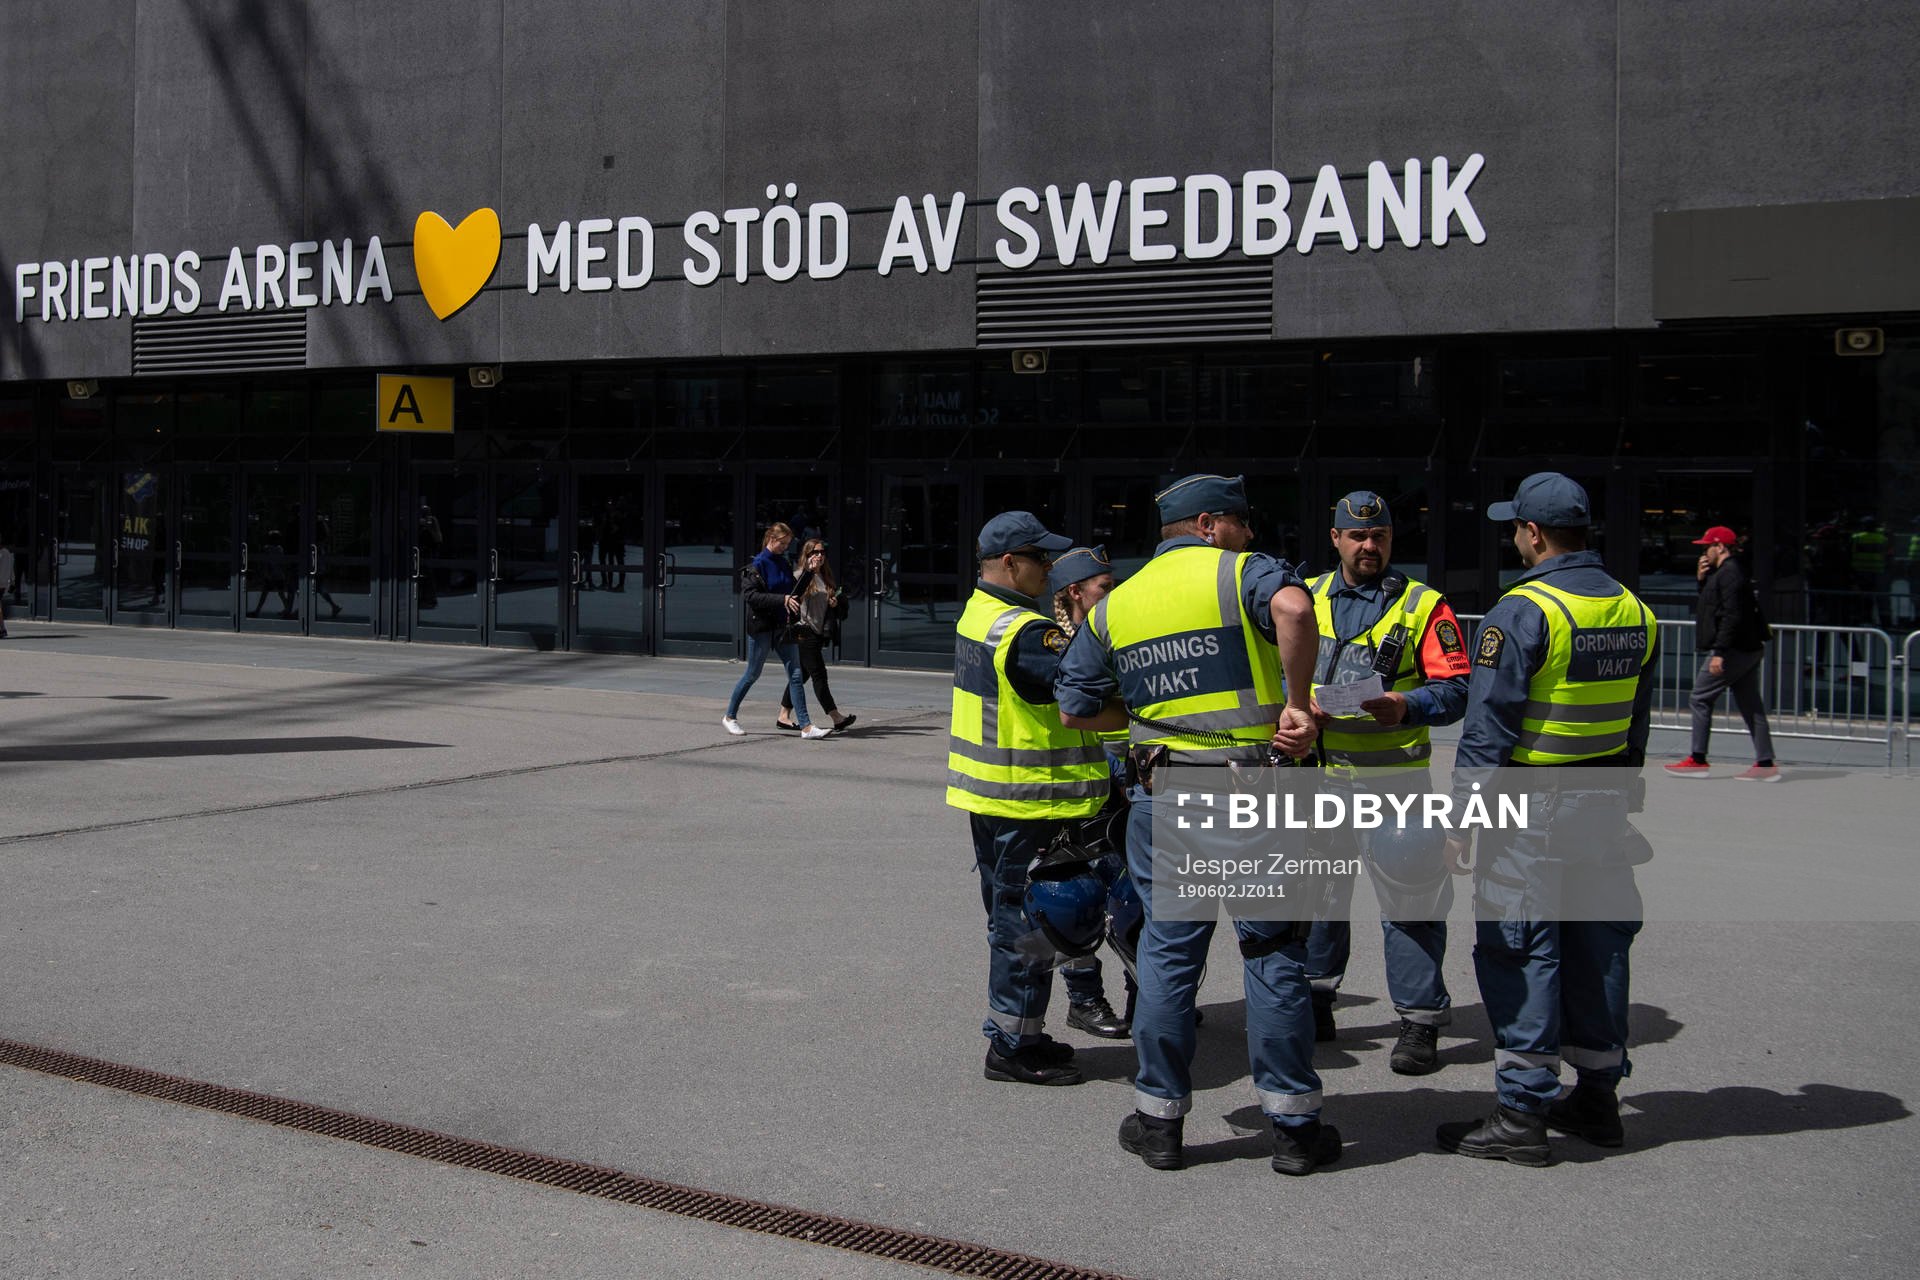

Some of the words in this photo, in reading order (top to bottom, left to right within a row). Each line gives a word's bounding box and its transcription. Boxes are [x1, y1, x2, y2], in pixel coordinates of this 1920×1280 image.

[15, 250, 201, 322] FRIENDS
[219, 236, 393, 311] ARENA
[527, 217, 654, 294] MED
[682, 183, 849, 286] STÖD
[877, 191, 966, 276] AV
[995, 153, 1486, 268] SWEDBANK
[388, 383, 424, 423] A
[122, 515, 150, 535] AIK
[1117, 634, 1220, 674] ORDNINGS
[1575, 632, 1646, 652] ORDNINGS
[1144, 667, 1199, 697] VAKT
[1597, 657, 1633, 677] VAKT
